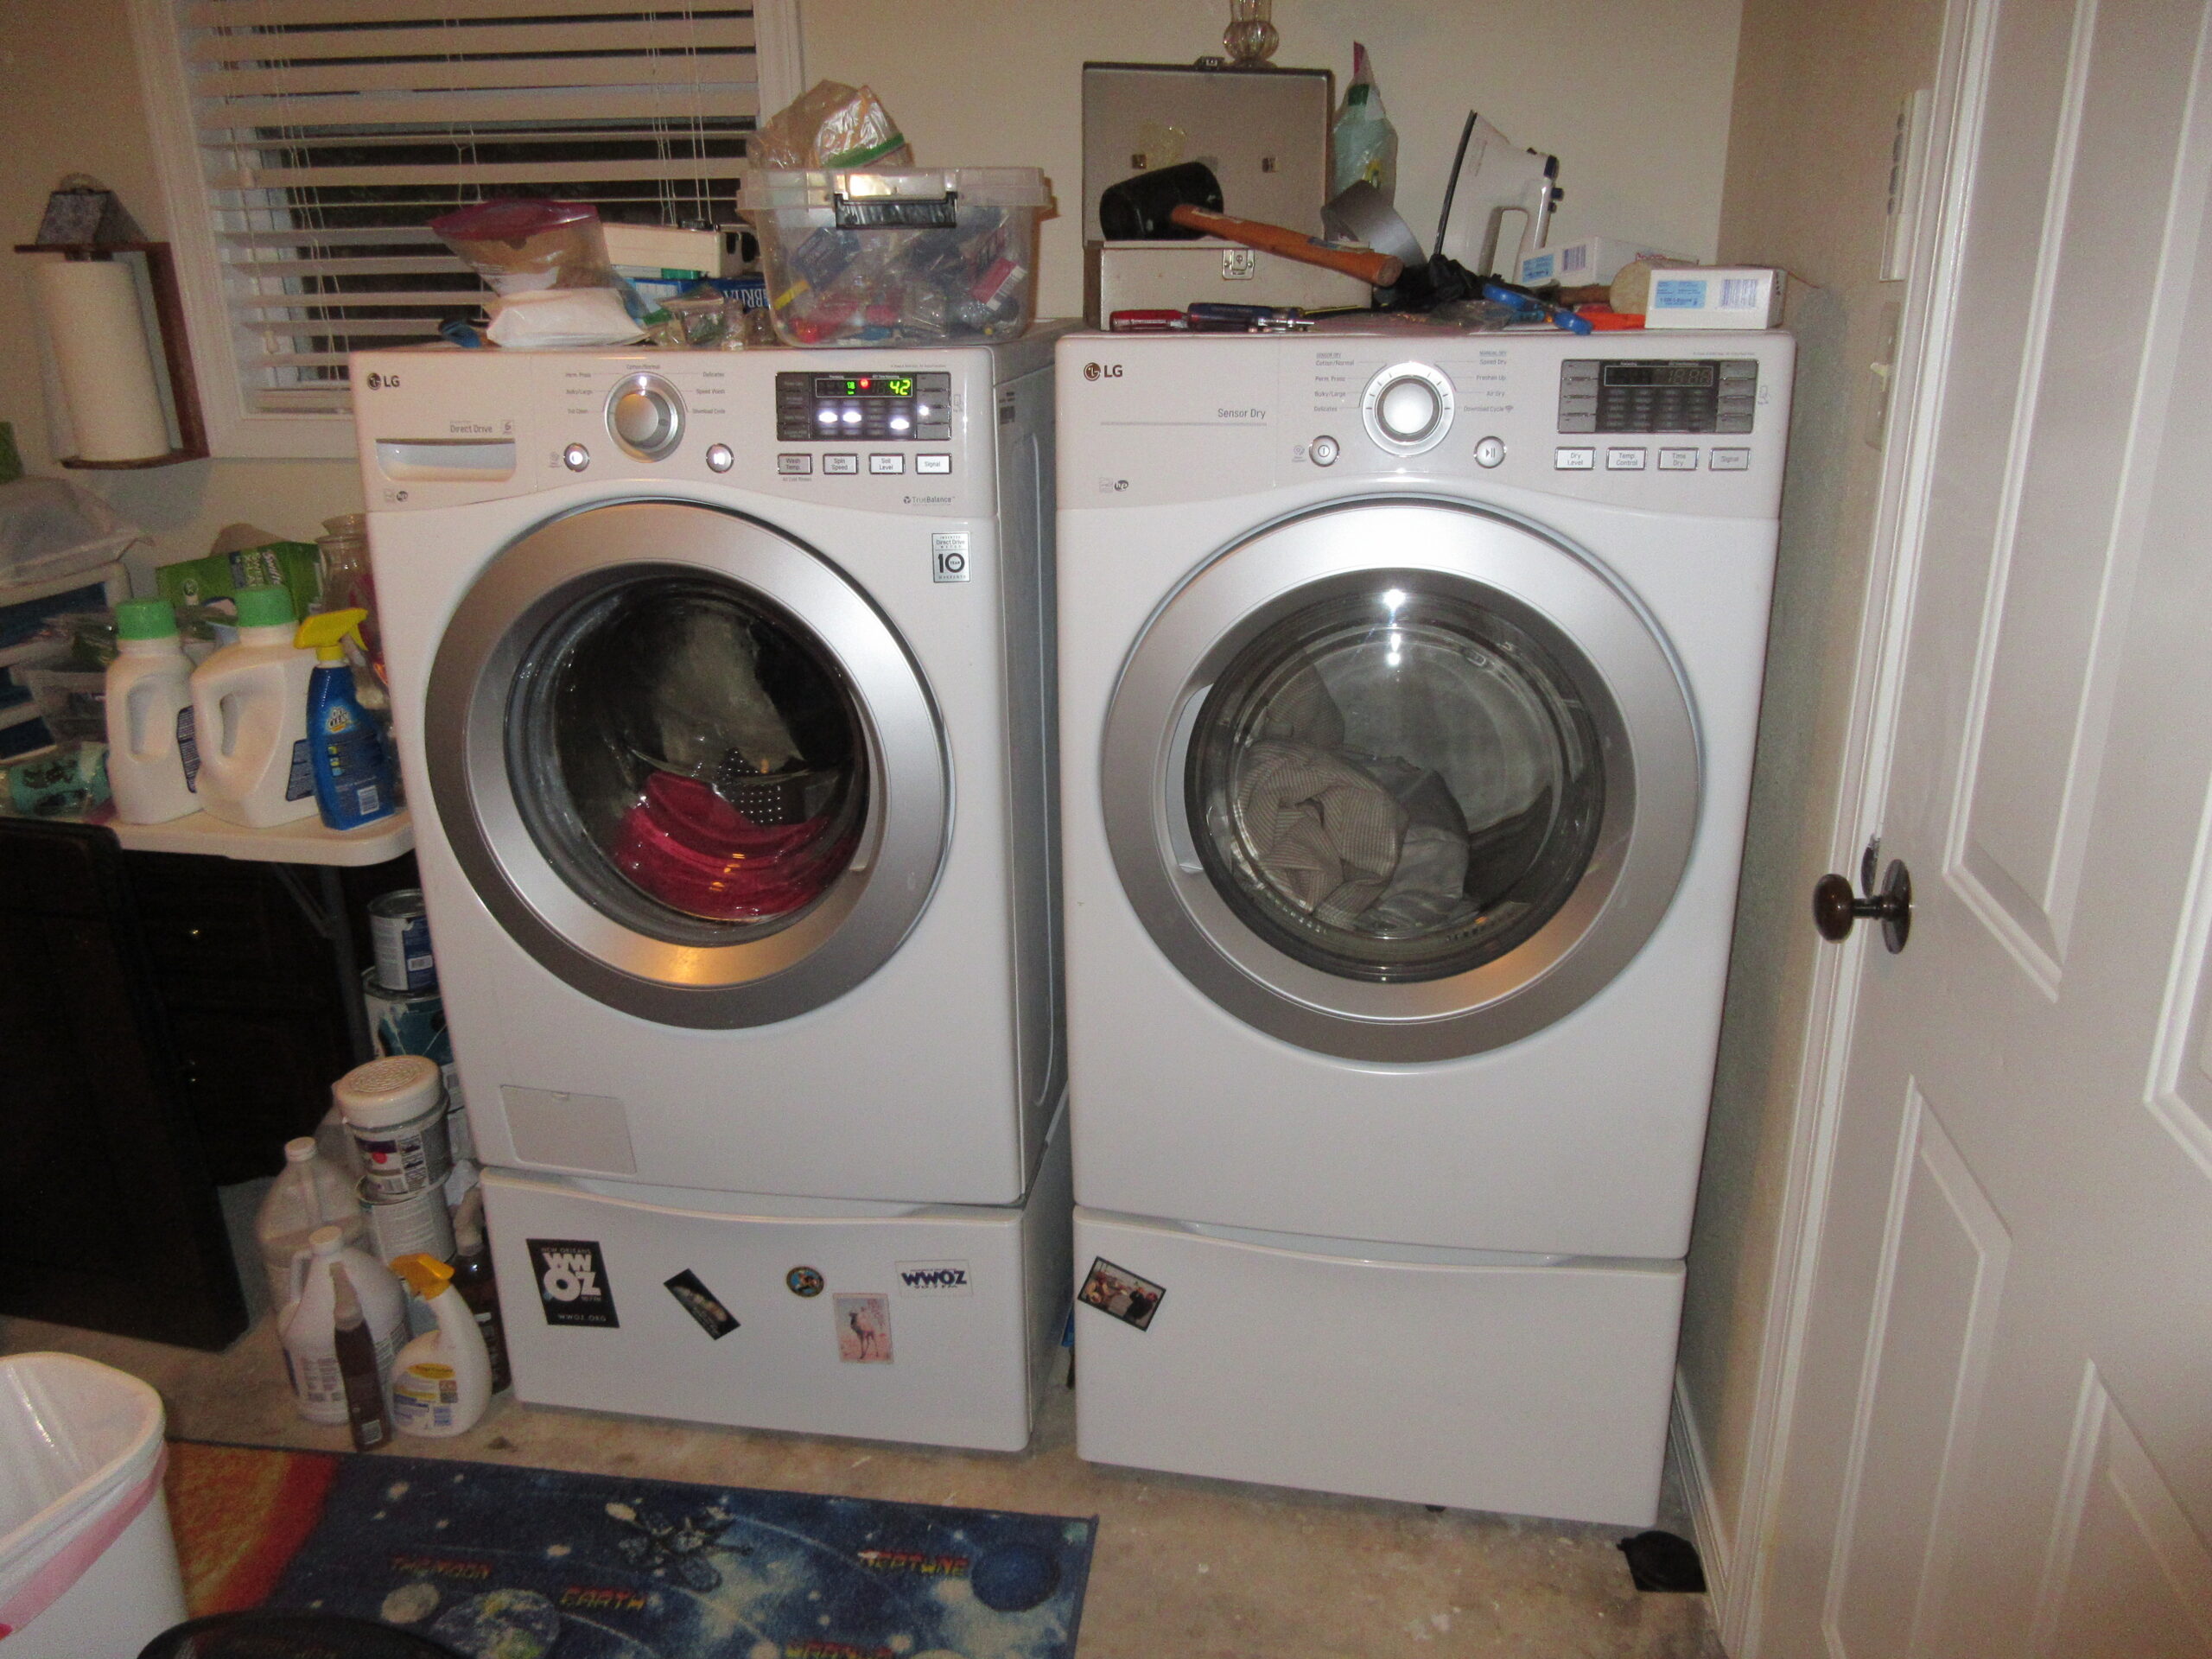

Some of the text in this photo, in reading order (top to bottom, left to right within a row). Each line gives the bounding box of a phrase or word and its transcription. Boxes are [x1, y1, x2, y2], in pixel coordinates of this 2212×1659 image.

[1104, 365, 1122, 378] LG
[384, 376, 400, 387] LG
[890, 379, 911, 396] 42
[1218, 408, 1266, 420] Sensor Dry
[450, 424, 472, 433] Direct
[474, 424, 493, 433] Drive
[938, 552, 965, 573] 10
[901, 1268, 968, 1287] WWOZ
[558, 1584, 649, 1611] EARTH
